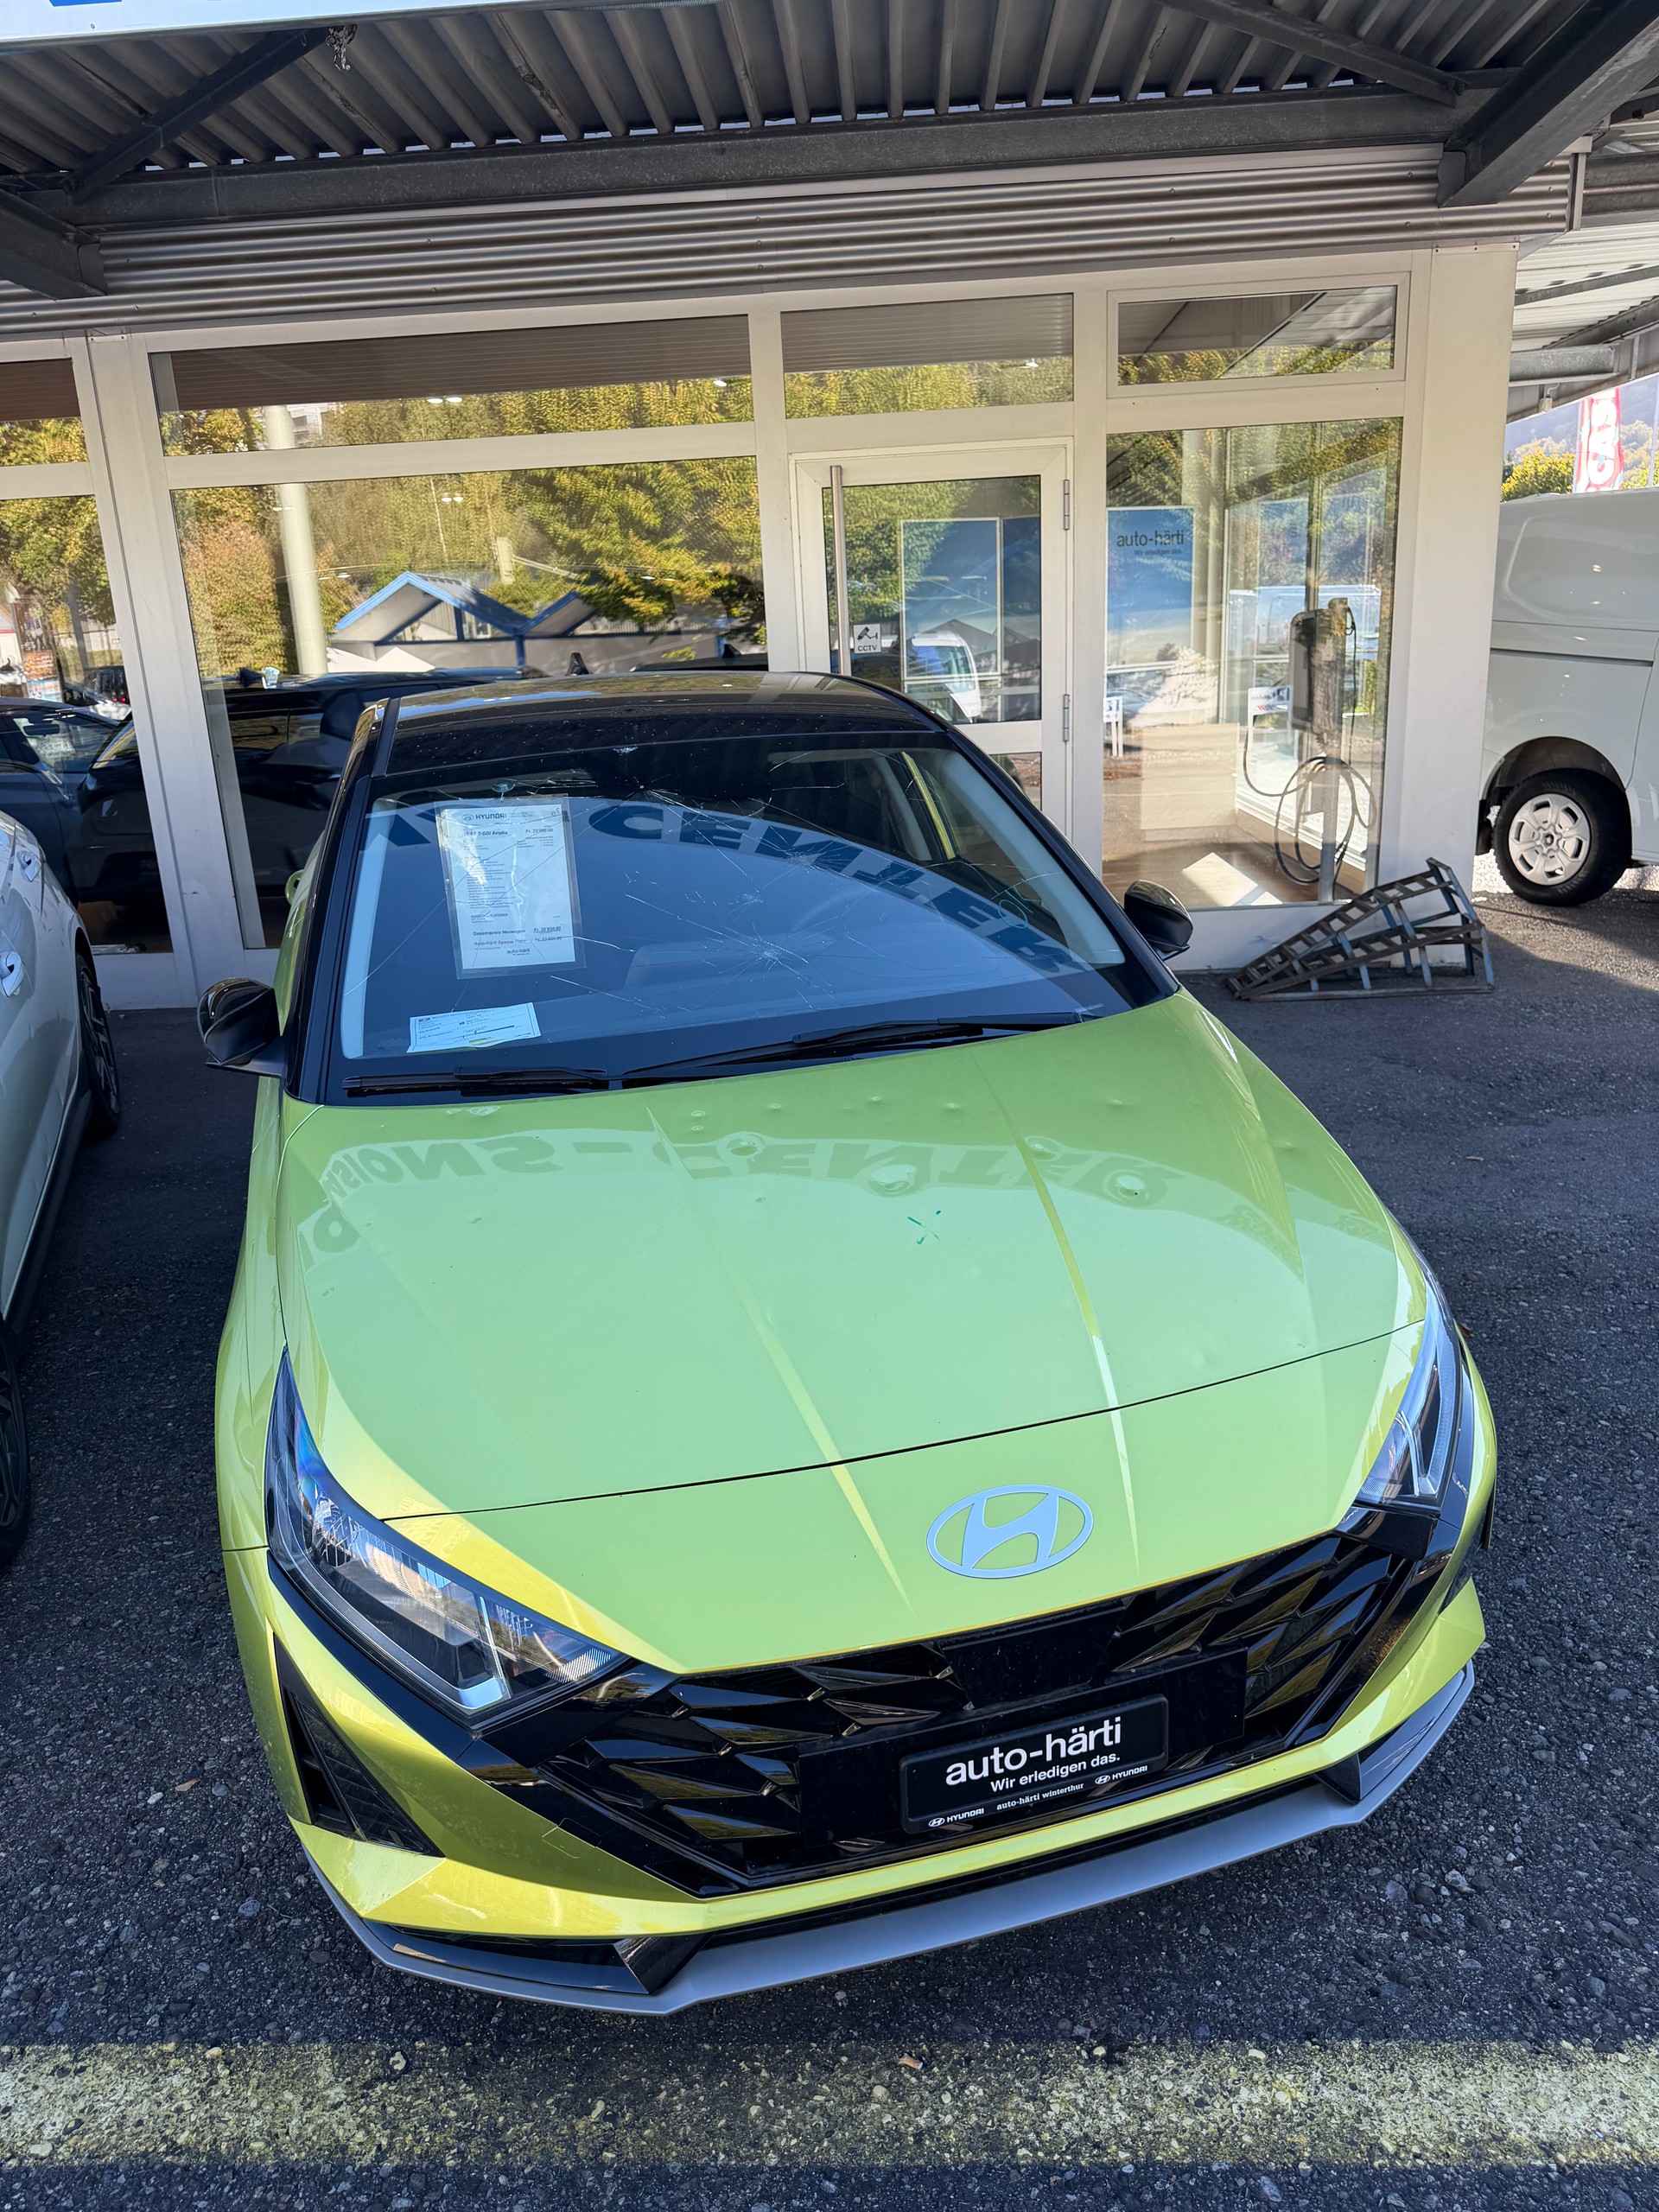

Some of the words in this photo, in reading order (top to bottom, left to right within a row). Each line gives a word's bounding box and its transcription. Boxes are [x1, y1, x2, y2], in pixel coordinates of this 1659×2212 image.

[1116, 530, 1184, 547] auto-härti
[945, 1716, 1122, 1786] auto-härti
[990, 1777, 1016, 1793] Wir
[1019, 1761, 1087, 1788] erledigen
[1090, 1751, 1121, 1768] das.
[946, 1808, 985, 1822] HYUNDAI
[996, 1793, 1040, 1811] auto-härti
[1042, 1782, 1084, 1799] winterthur
[1111, 1765, 1148, 1781] HYUNDAI
